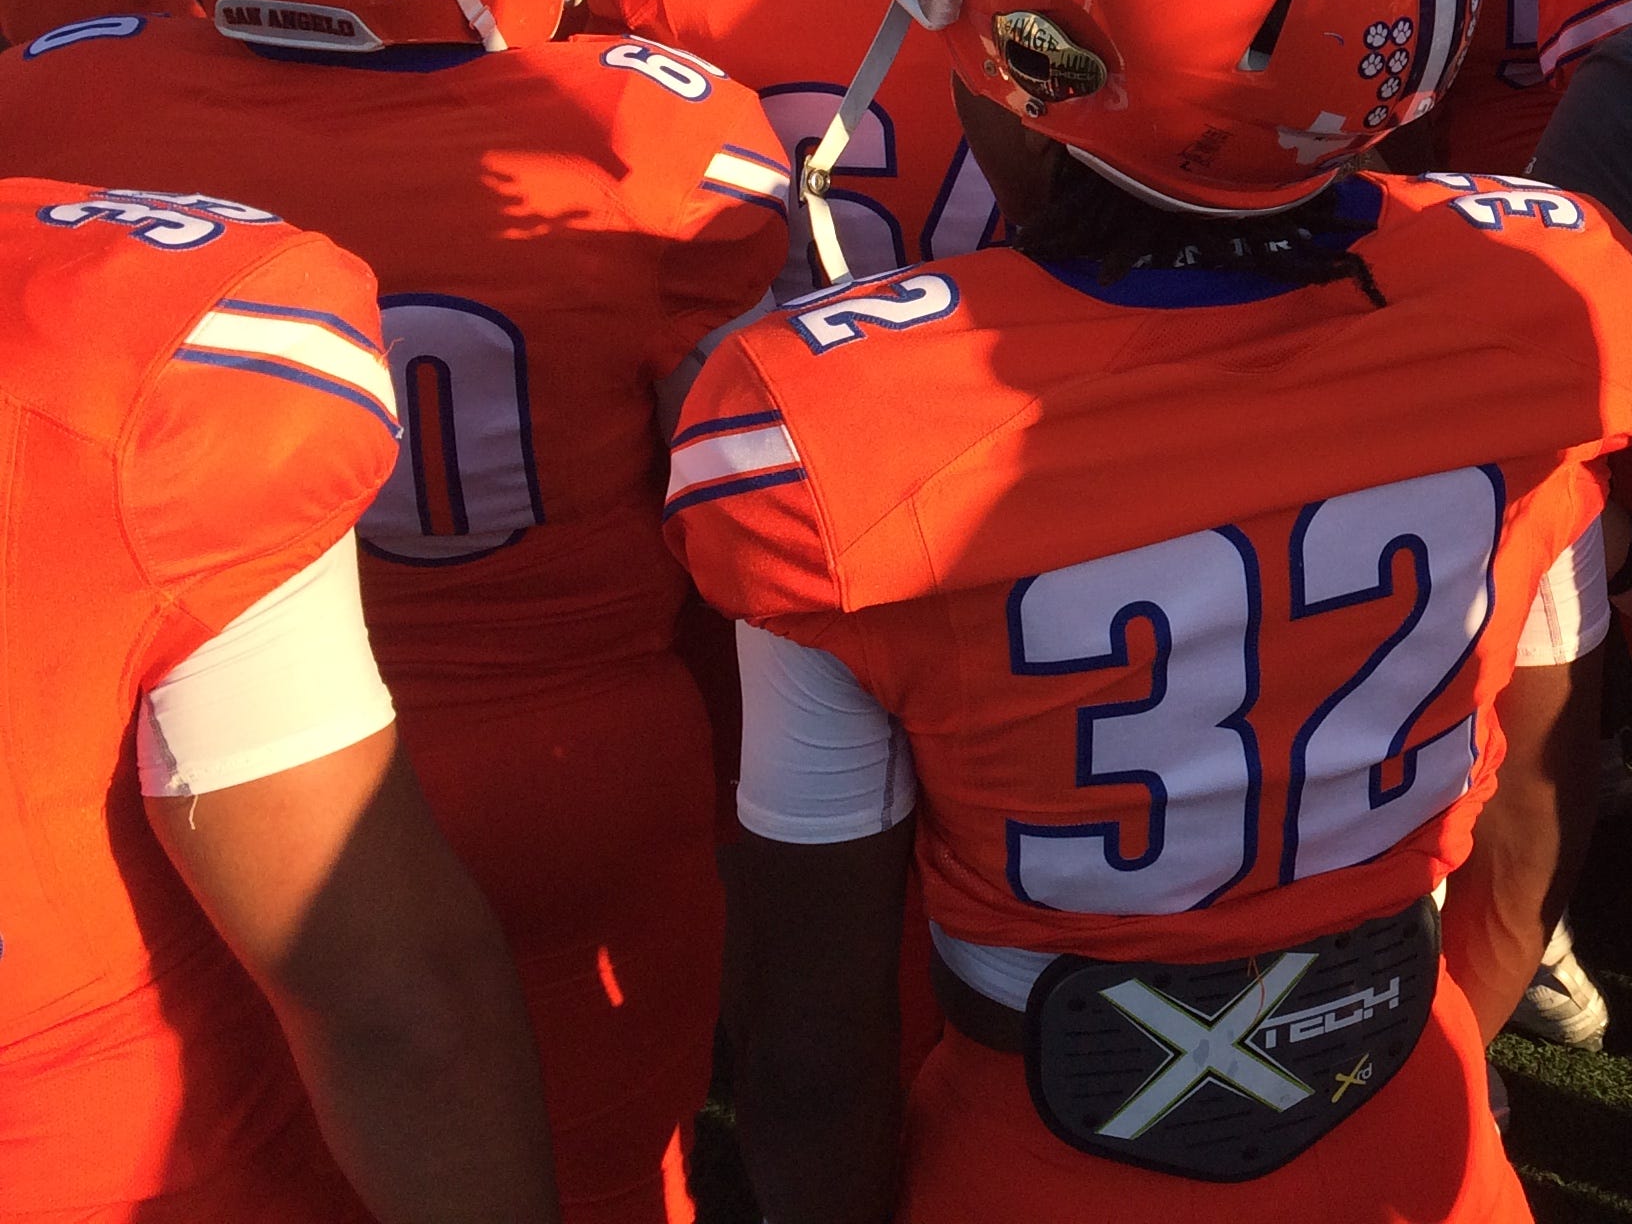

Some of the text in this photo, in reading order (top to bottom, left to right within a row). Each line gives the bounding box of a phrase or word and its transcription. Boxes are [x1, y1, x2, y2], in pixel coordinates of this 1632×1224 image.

[221, 6, 357, 38] SAN ANGELO
[1004, 462, 1507, 919] 32
